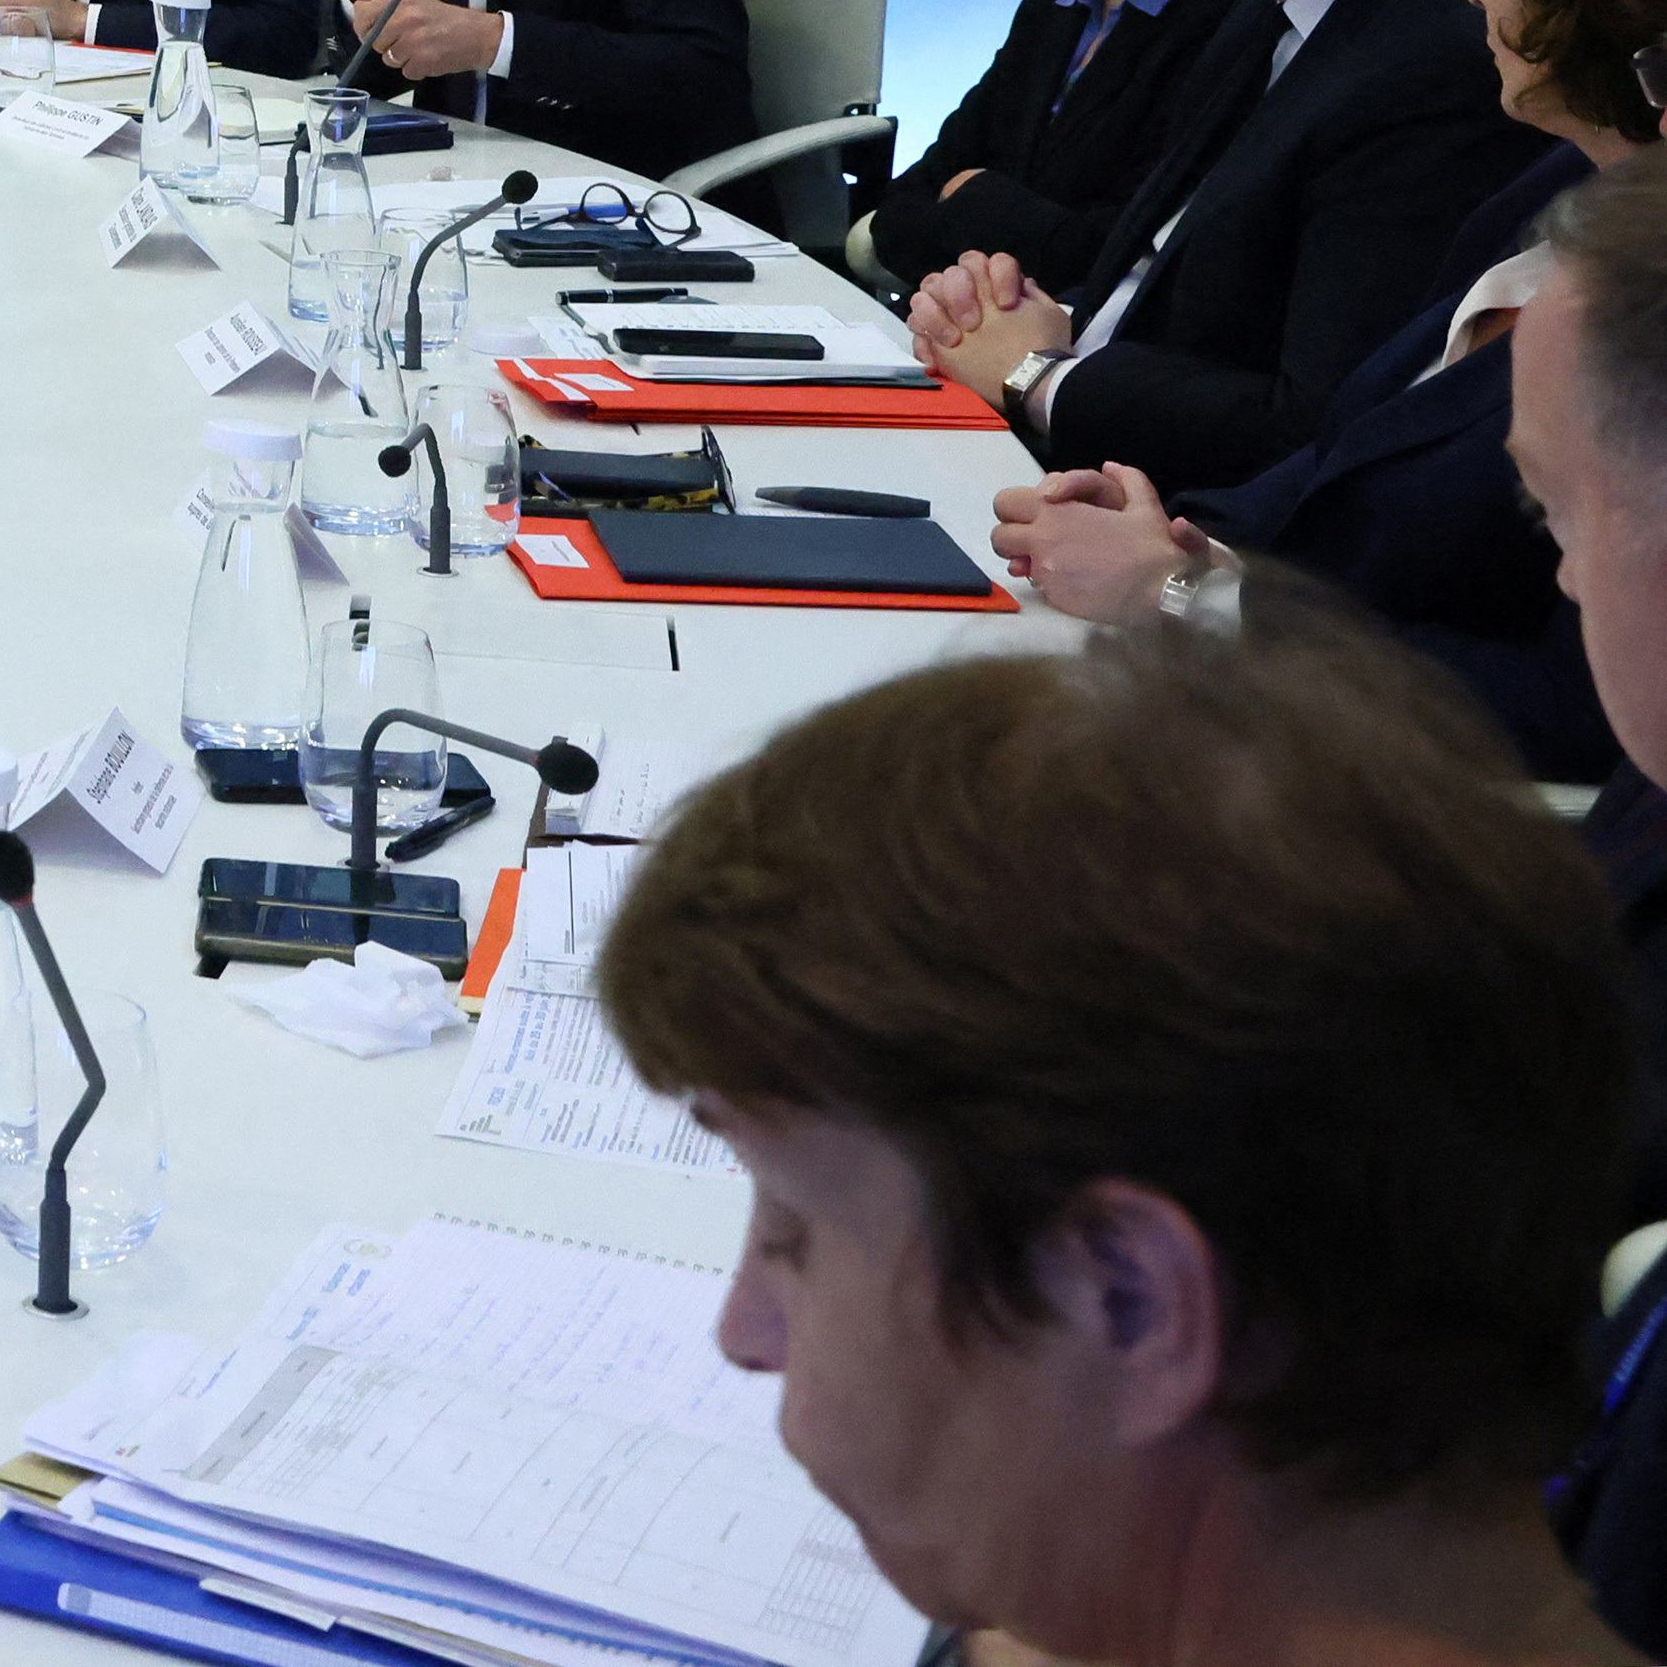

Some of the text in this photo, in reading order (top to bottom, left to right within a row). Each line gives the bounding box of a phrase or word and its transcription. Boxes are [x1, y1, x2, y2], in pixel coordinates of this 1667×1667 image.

[67, 110, 105, 126] GUSTIN
[86, 730, 135, 804] Stéphane BOUILLON
